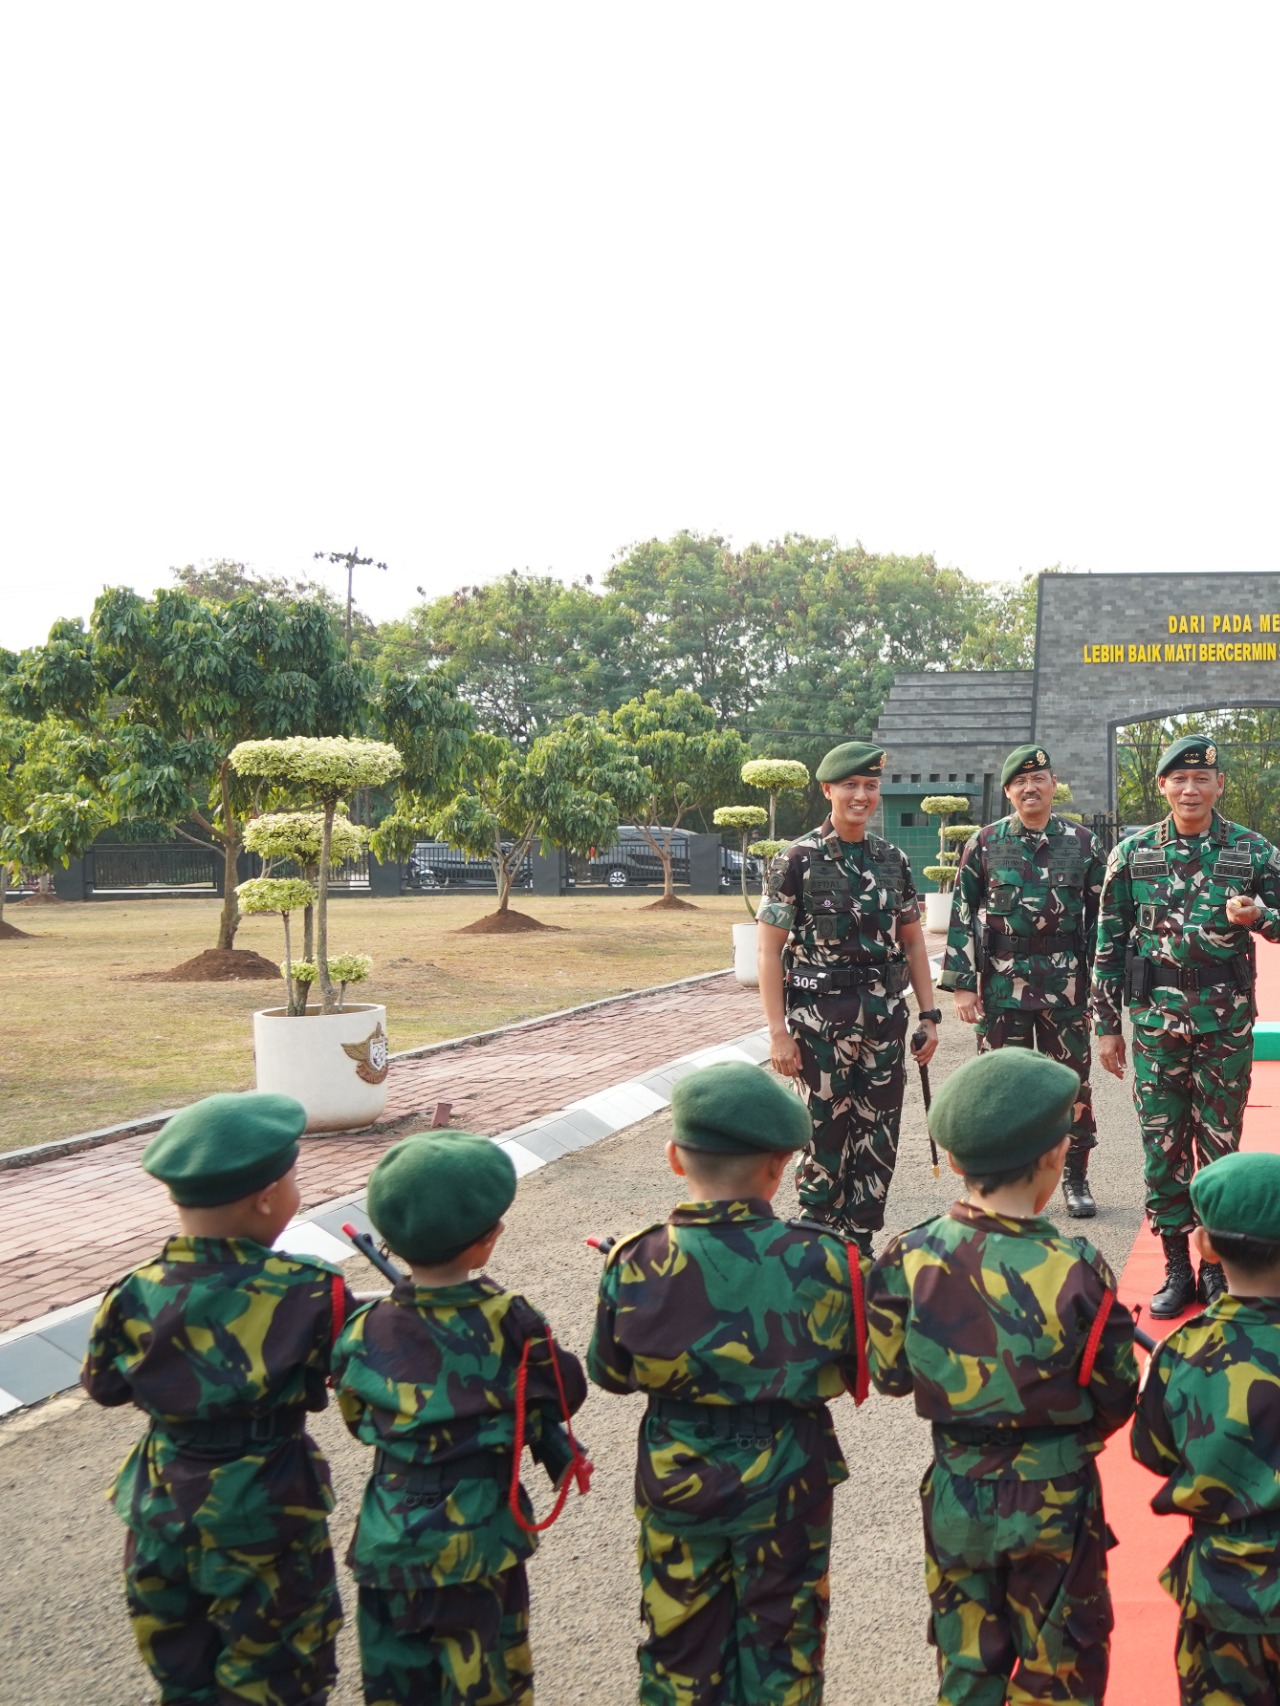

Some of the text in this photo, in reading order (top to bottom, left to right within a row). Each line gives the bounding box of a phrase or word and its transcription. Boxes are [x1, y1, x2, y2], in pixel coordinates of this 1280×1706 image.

[1168, 615, 1205, 634] DARI
[1212, 614, 1253, 633] PADA
[1083, 644, 1125, 663] LEBIH
[1128, 644, 1162, 662] BAIK
[1164, 643, 1197, 662] MATI
[1198, 642, 1277, 662] BERCERMIN
[793, 975, 818, 990] 305
